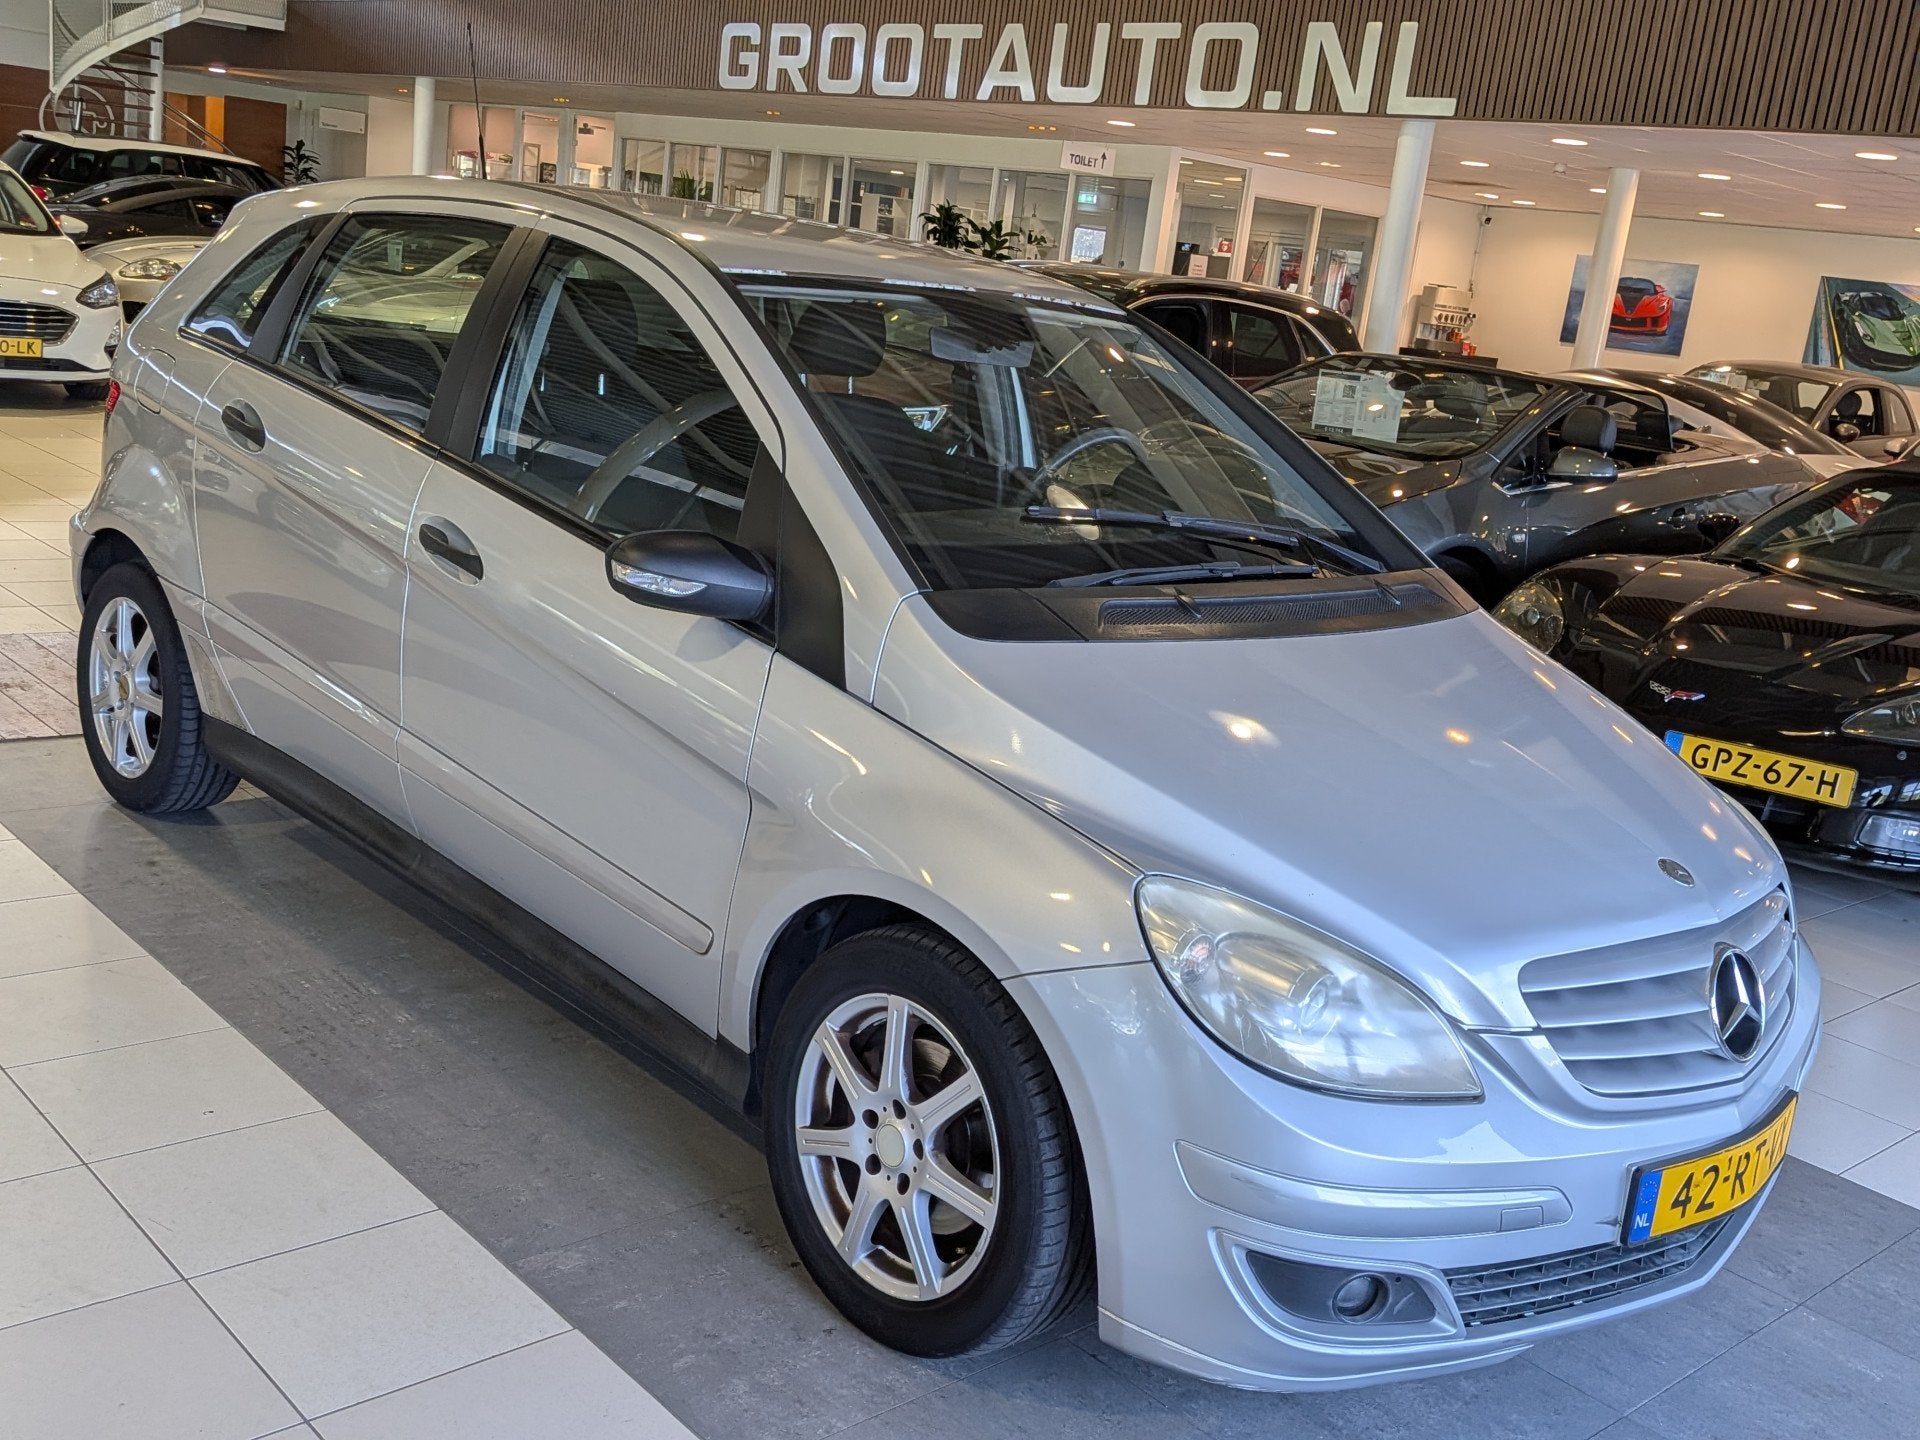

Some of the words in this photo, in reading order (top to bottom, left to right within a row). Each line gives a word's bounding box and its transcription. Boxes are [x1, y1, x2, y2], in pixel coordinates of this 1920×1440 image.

[719, 22, 1457, 116] GROOTAUTO.NL
[1069, 153, 1099, 168] TOILET
[1691, 743, 1840, 798] GPZ-67-H
[1634, 1213, 1650, 1229] NL
